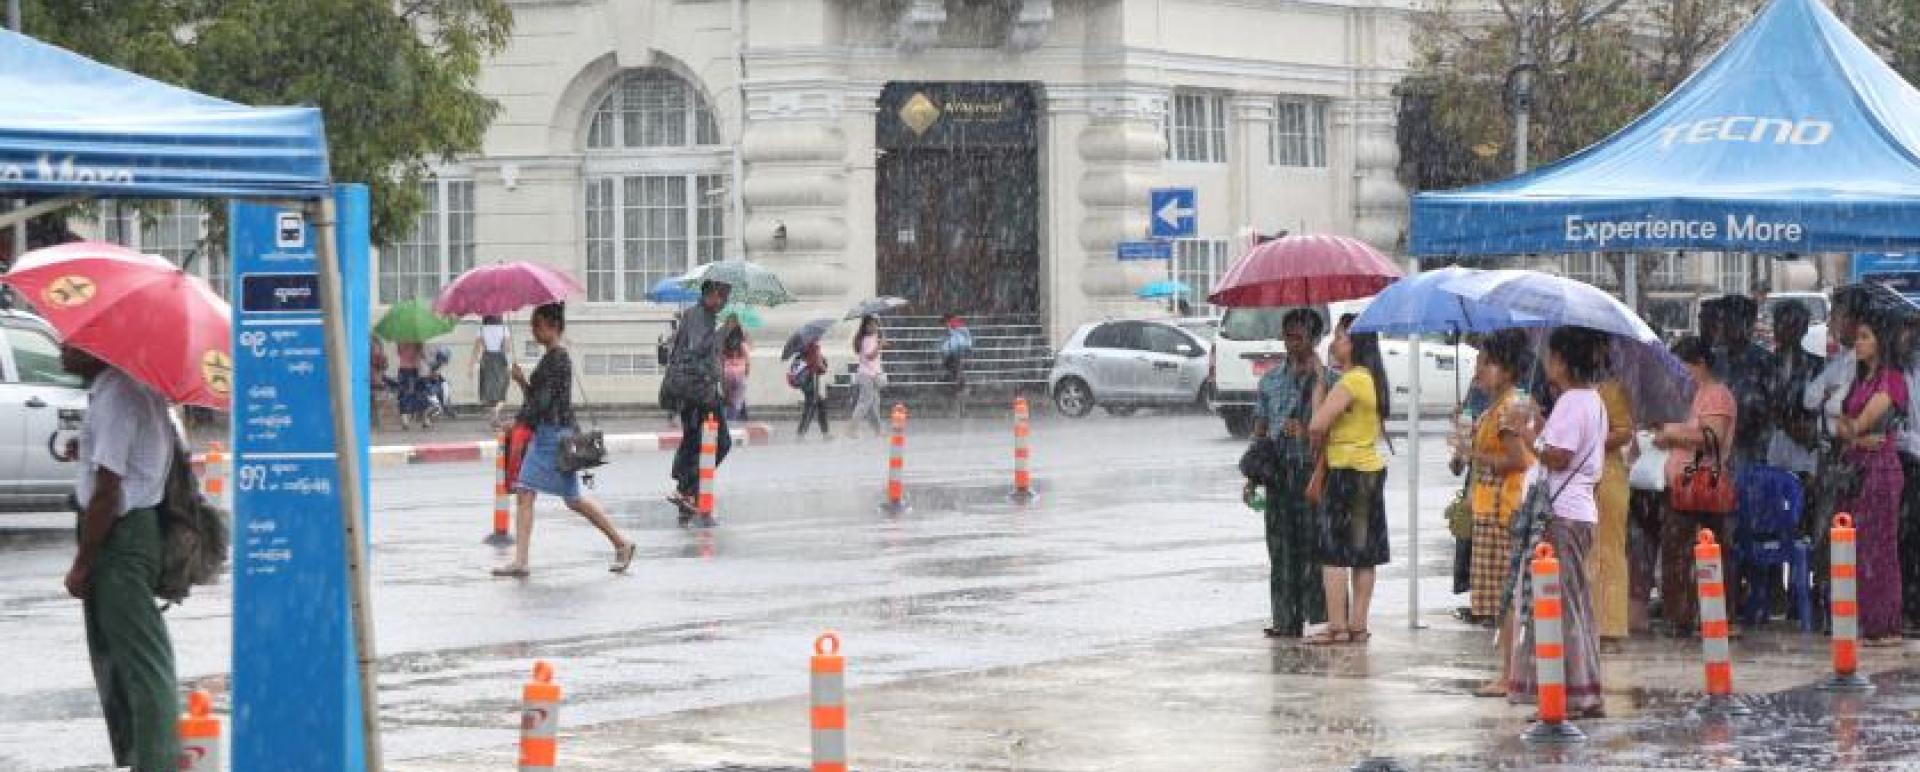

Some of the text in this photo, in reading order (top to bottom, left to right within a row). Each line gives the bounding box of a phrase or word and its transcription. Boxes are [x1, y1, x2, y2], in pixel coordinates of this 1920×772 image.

[1659, 116, 1833, 147] TECNO
[1566, 214, 1802, 247] Experience More
